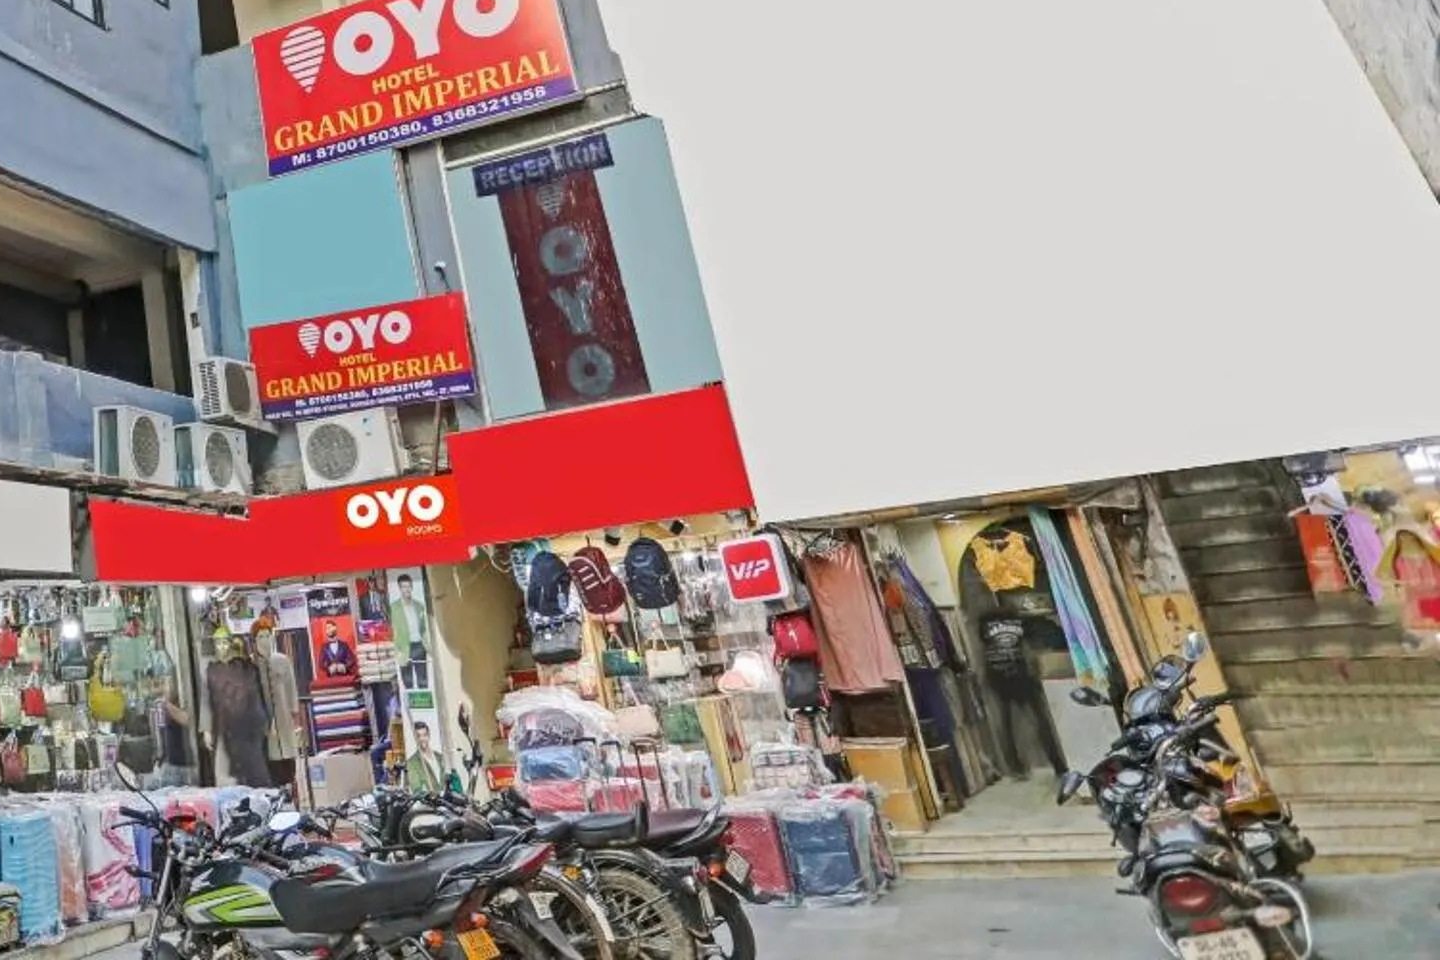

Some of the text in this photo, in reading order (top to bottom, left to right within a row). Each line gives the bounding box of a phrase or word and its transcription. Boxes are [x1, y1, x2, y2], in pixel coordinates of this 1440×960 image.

[274, 50, 560, 152] GRAND IMPERIAL
[371, 63, 440, 95] HOTEL
[291, 85, 547, 166] M: 8700150380, 8368321958
[480, 140, 607, 190] RECEPTION
[323, 310, 412, 354] OYO
[539, 225, 615, 396] OYO
[266, 350, 464, 399] GRAND IMPERIAL
[339, 352, 377, 367] HOTEL
[346, 484, 445, 529] OYO
[730, 558, 770, 581] VIP
